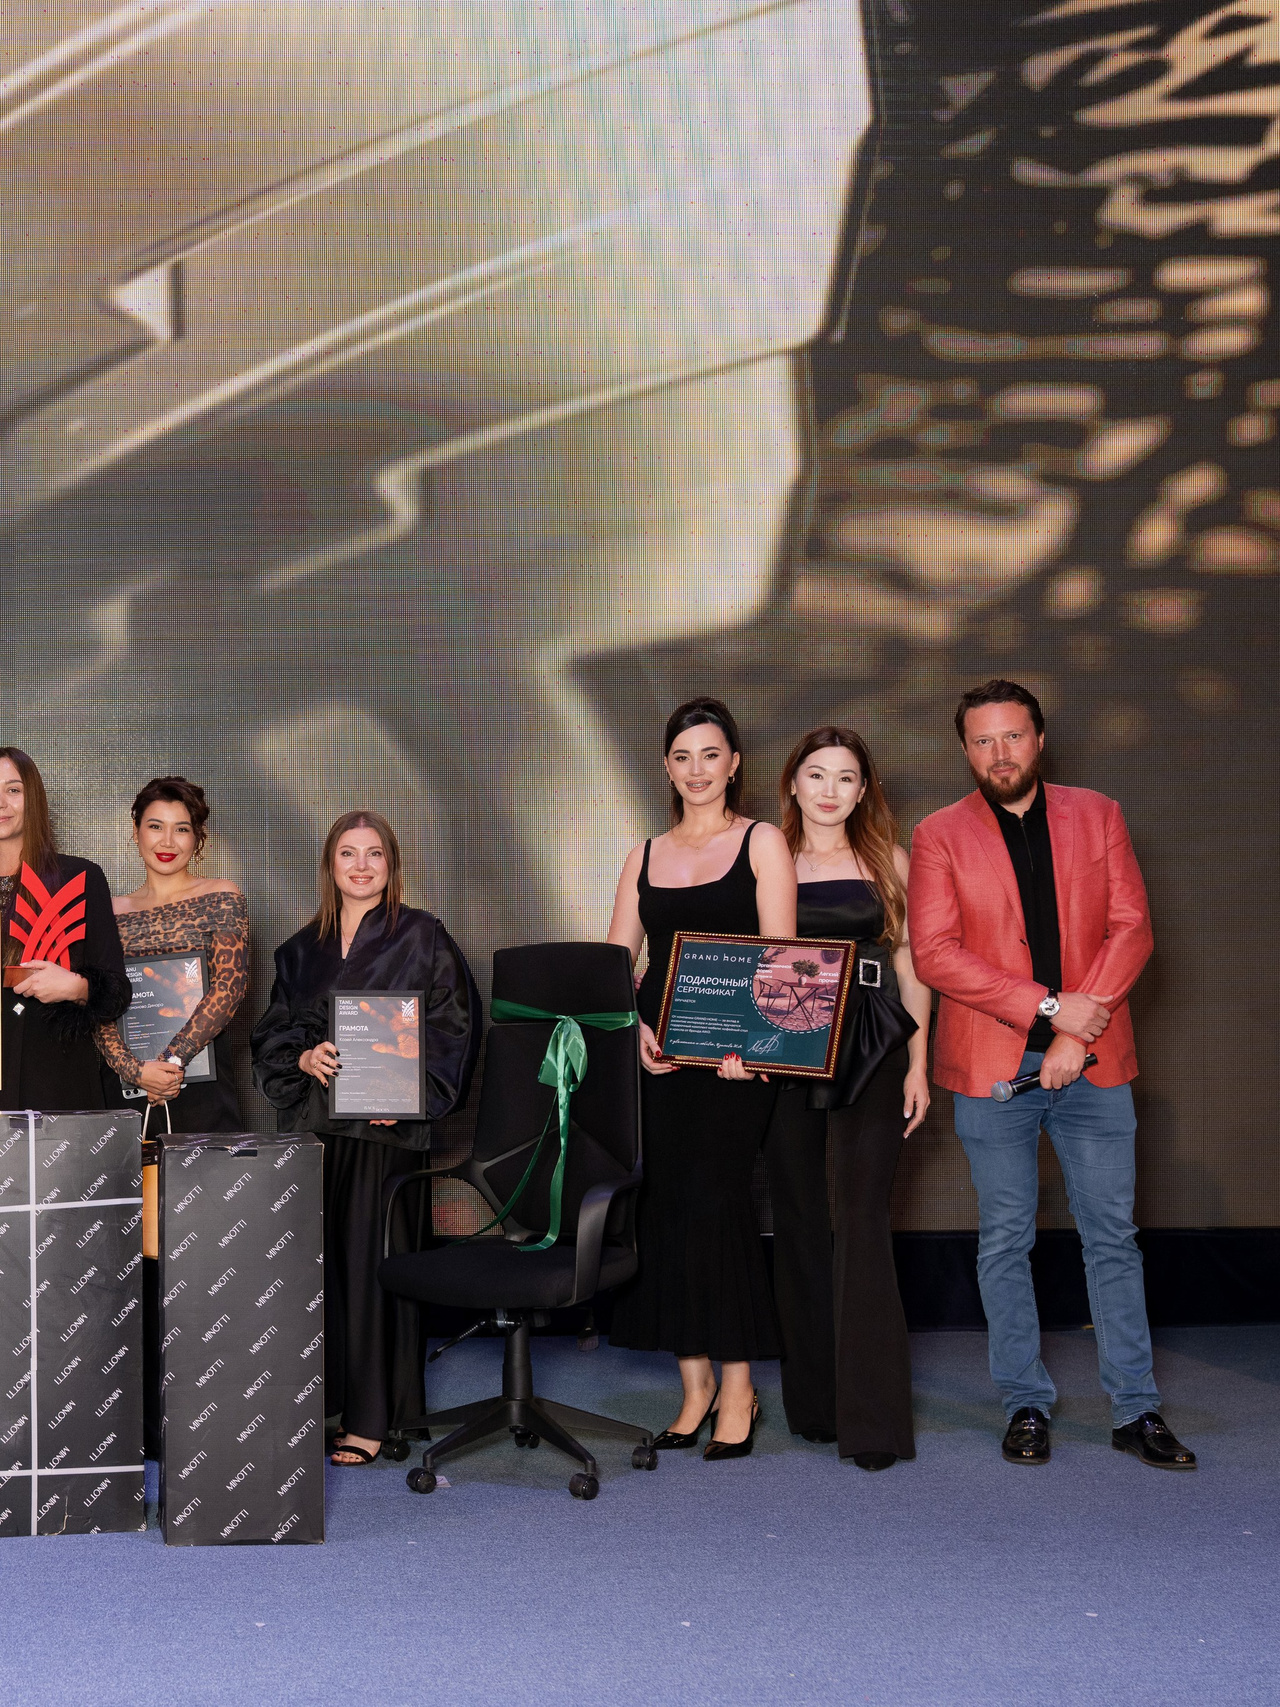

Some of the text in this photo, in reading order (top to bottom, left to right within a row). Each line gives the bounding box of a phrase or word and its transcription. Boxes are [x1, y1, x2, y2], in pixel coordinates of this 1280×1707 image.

[677, 986, 736, 996] СЕРТИФИКАТ
[679, 974, 748, 987] ПОДАРОЧНЫЙ
[43, 1139, 70, 1168] MINOTTI
[90, 1126, 118, 1155] MINOTTI
[80, 1173, 108, 1202] MINOTTI
[174, 1185, 203, 1214] MINOTTI
[223, 1173, 252, 1202] MINOTTI
[271, 1184, 299, 1214] MINOTTI
[76, 1219, 104, 1248] MINOTTI
[169, 1232, 198, 1261] MINOTTI
[218, 1219, 247, 1248] MINOTTI
[266, 1231, 294, 1260] MINOTTI
[70, 1265, 98, 1294] MINOTTI
[117, 1252, 143, 1280] MINOTTI
[207, 1267, 237, 1296] MINOTTI
[255, 1279, 284, 1308] MINOTTI
[112, 1298, 139, 1327] MINOTTI
[60, 1313, 88, 1342] MINOTTI
[202, 1314, 230, 1344] MINOTTI
[248, 1326, 278, 1355] MINOTTI
[54, 1356, 82, 1385] MINOTTI
[101, 1345, 129, 1374] MINOTTI
[196, 1358, 225, 1388] MINOTTI
[243, 1370, 272, 1400] MINOTTI
[294, 1375, 322, 1405] MINOTTI
[48, 1400, 76, 1429] MINOTTI
[95, 1388, 123, 1417] MINOTTI
[189, 1402, 218, 1431] MINOTTI
[0, 1415, 29, 1444] MINOTTI
[236, 1414, 265, 1443] MINOTTI
[288, 1418, 316, 1448] MINOTTI
[89, 1432, 117, 1462] MINOTTI
[178, 1450, 207, 1480] MINOTTI
[226, 1462, 255, 1491] MINOTTI
[84, 1478, 112, 1507] MINOTTI
[277, 1467, 306, 1496] MINOTTI
[173, 1497, 201, 1527] MINOTTI
[220, 1509, 249, 1538] MINOTTI
[271, 1514, 300, 1543] MINOTTI
